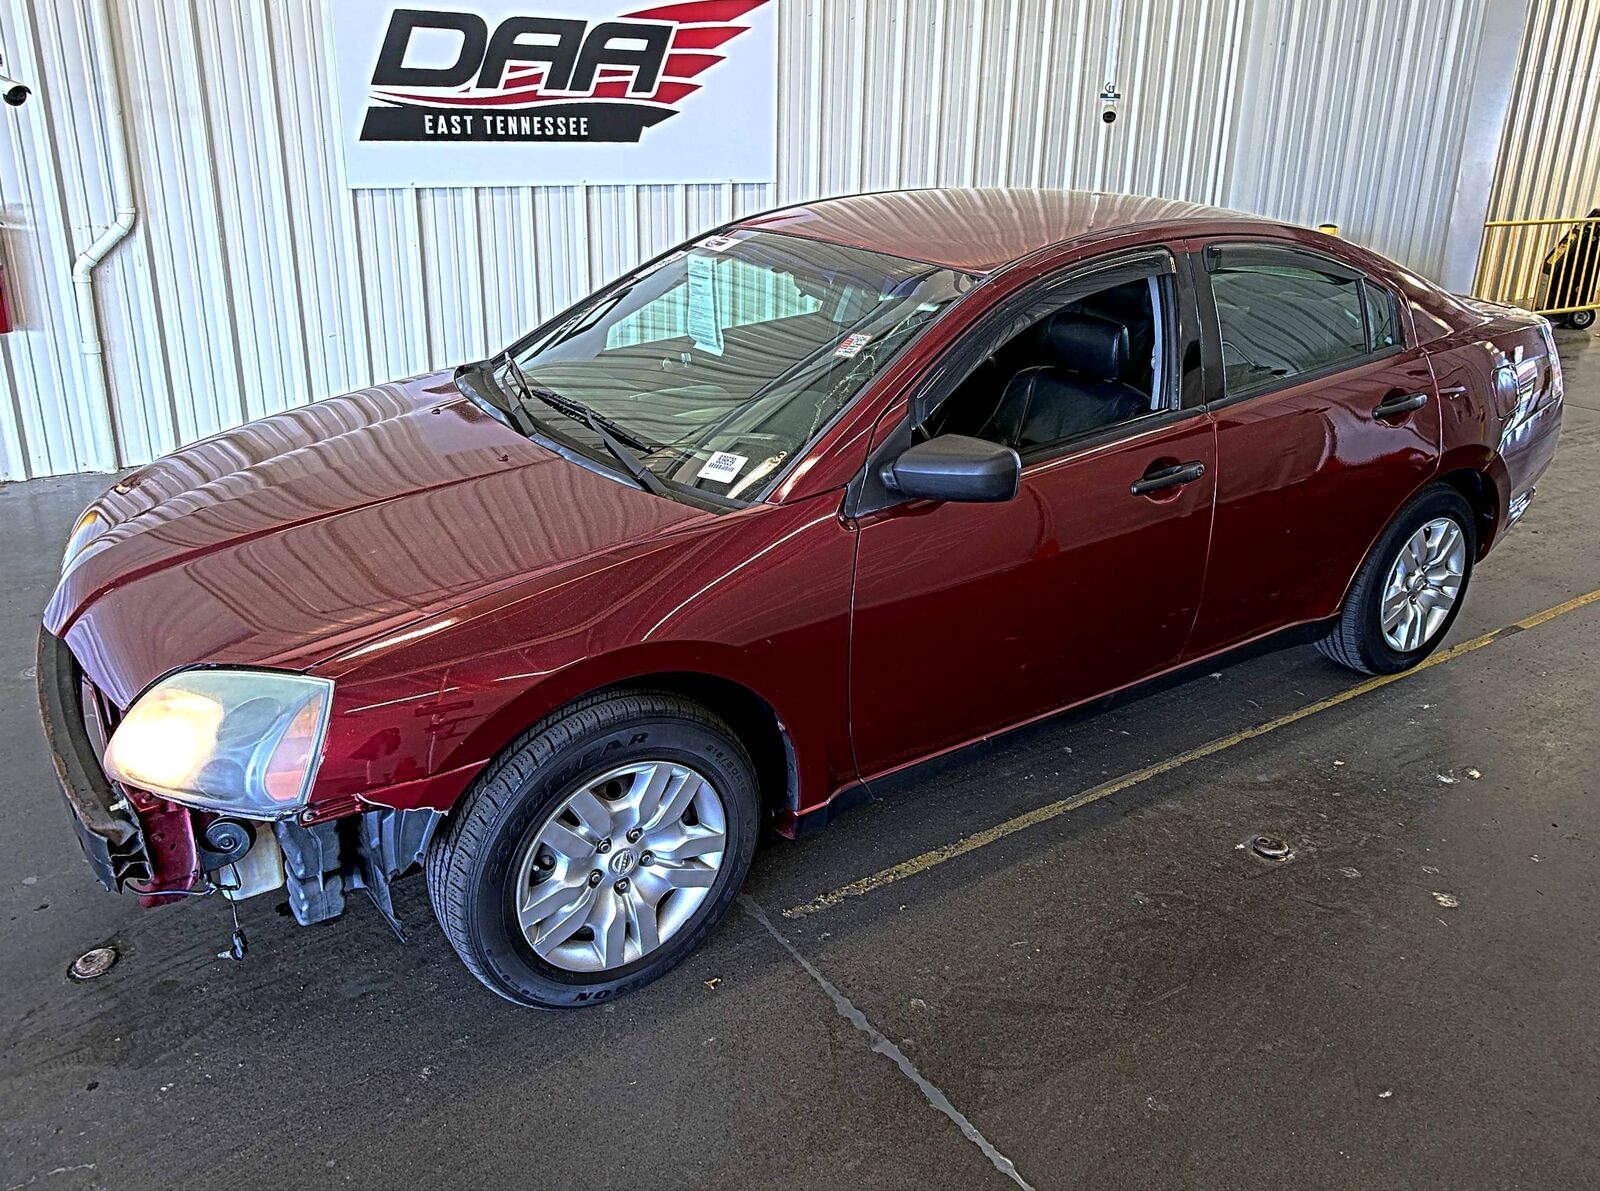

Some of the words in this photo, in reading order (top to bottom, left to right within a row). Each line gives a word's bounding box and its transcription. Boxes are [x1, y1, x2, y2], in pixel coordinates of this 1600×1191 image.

[371, 8, 674, 93] DAA
[424, 114, 473, 135] EAST
[483, 115, 589, 136] TENNESSEE
